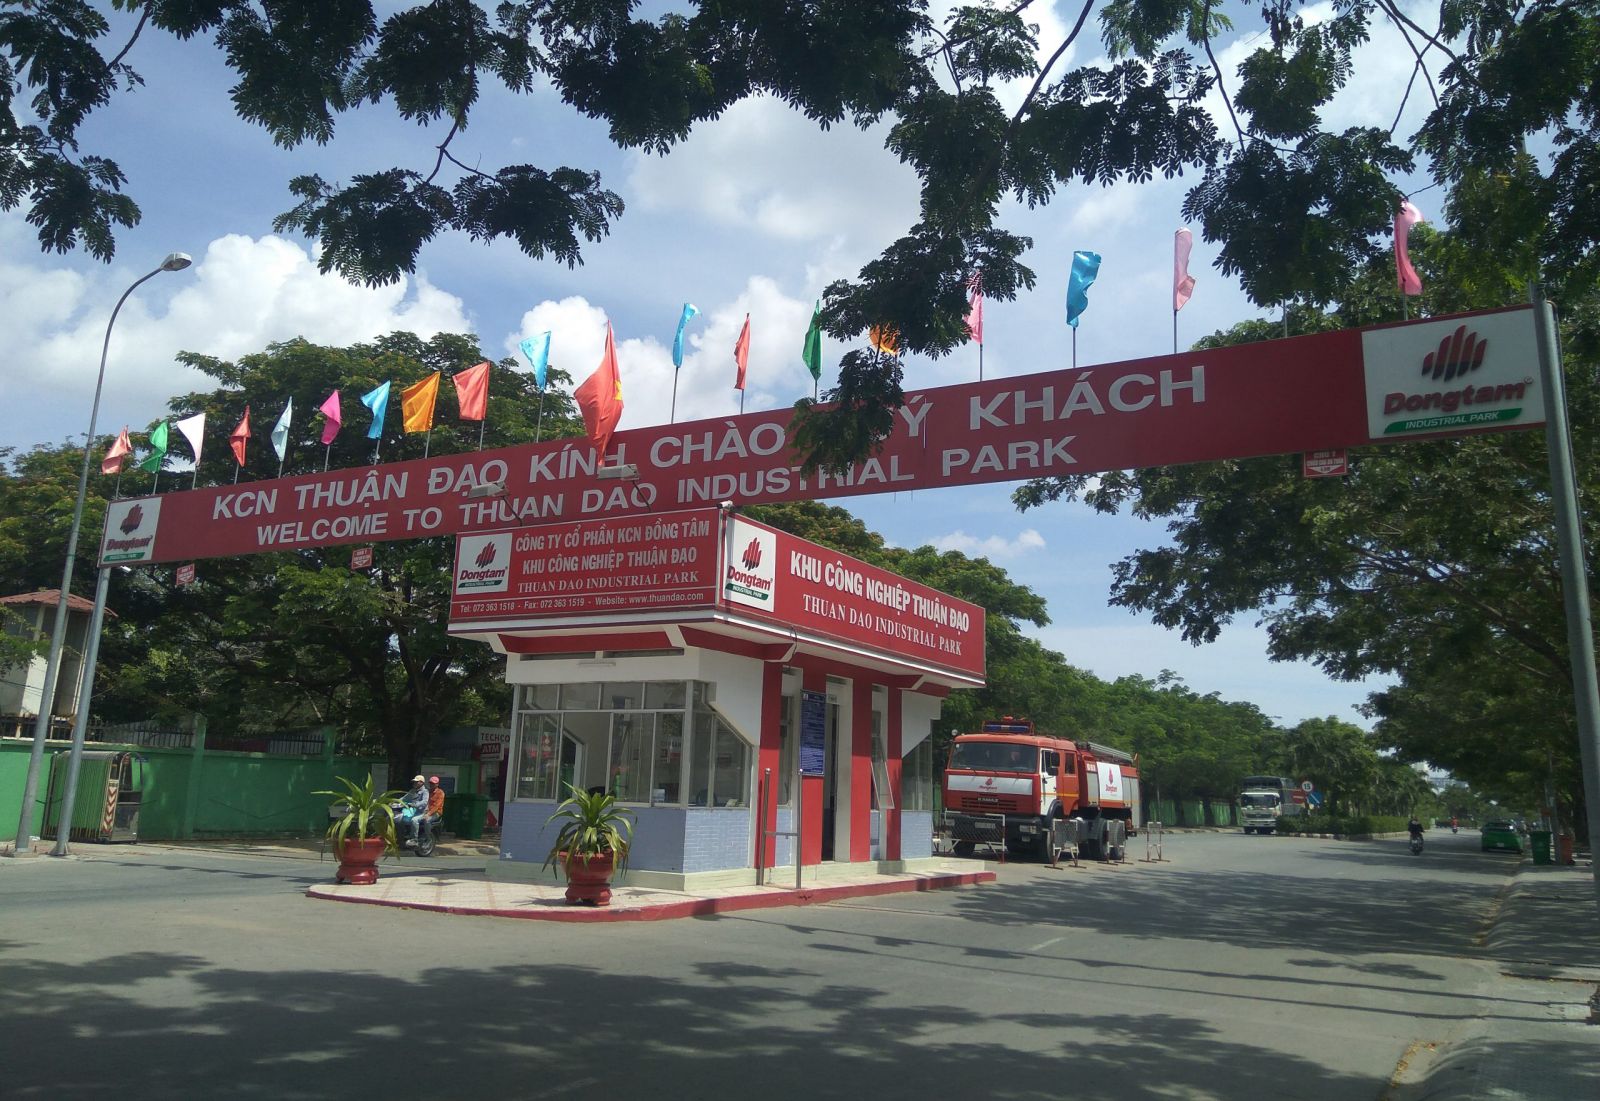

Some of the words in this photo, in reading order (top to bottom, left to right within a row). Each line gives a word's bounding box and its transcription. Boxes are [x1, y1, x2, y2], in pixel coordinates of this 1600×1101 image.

[1383, 382, 1526, 415] Dongtam
[1405, 415, 1467, 430] INDUSTRIAL
[1469, 411, 1500, 422] PARK
[212, 488, 278, 520] KCN
[294, 469, 409, 510] THUẬN
[427, 459, 508, 497] ĐẠO
[649, 421, 786, 468] CHÀO
[969, 365, 1206, 431] KHÁCH
[257, 512, 389, 546] WELCOME
[402, 507, 443, 531] TO
[458, 493, 563, 526] THUAN
[581, 483, 657, 514] DAO
[942, 435, 1078, 477] PARK
[515, 533, 545, 552] CÔNG
[547, 533, 562, 549] TY
[564, 524, 581, 548] CỔ
[583, 523, 614, 546] PHẦN
[617, 526, 641, 543] KCN
[645, 518, 679, 541] ĐỒNG
[681, 517, 710, 538] TÂM
[459, 568, 506, 580] Dongtam
[522, 558, 545, 575] KHU
[548, 553, 579, 573] CÔNG
[581, 548, 624, 572] NGHIỆP
[627, 546, 668, 568] THUẬN
[671, 546, 697, 567] ĐẠO
[518, 581, 555, 593] THUAN
[558, 579, 584, 591] DAO
[586, 573, 660, 589] INDUSTRIAL
[663, 570, 699, 584] PARK
[727, 565, 771, 591] Dongtam
[790, 550, 822, 583] KHU
[824, 560, 863, 597] CÔNG
[866, 583, 911, 616] NGHIỆP
[912, 597, 947, 628] THUẬN
[949, 608, 969, 635] ĐẠO
[460, 604, 471, 613] Tel:
[472, 603, 485, 613] 072
[499, 602, 515, 611] 1518
[524, 600, 539, 609] Fax:
[540, 600, 553, 609] 072
[568, 598, 585, 607] 1519
[595, 596, 627, 606] Website:
[629, 592, 704, 604] www.thuandao.com
[803, 593, 846, 621] THUAN
[849, 607, 872, 629] DAO
[875, 616, 936, 648] INDUSTRIAL
[939, 635, 962, 656] PARK
[482, 744, 500, 753] ATM
